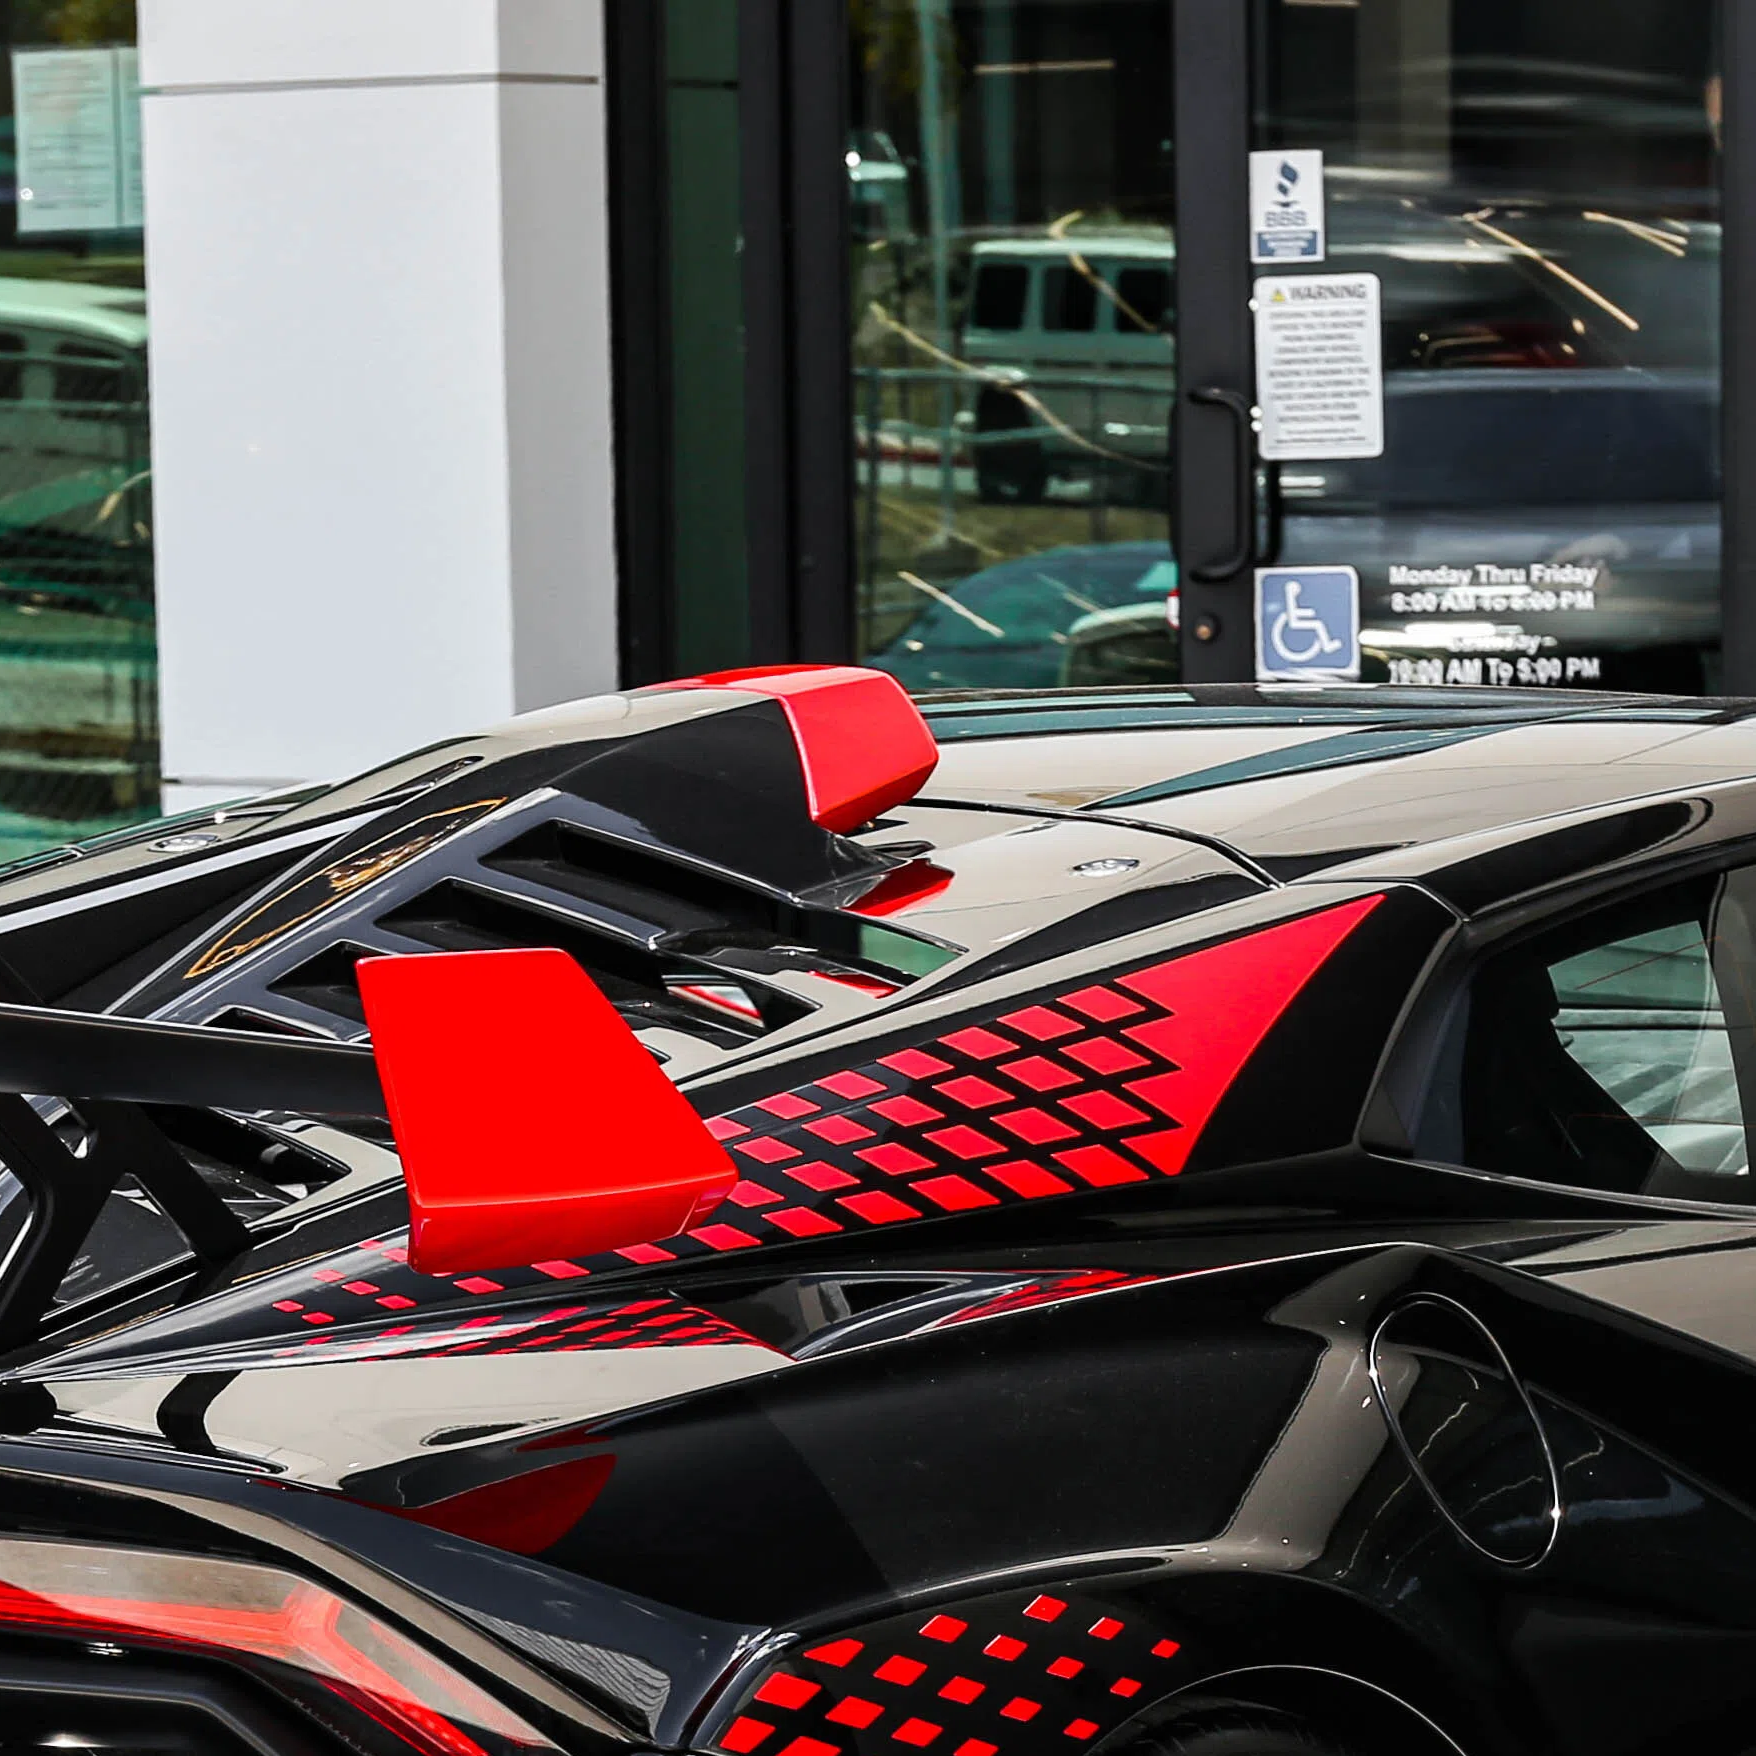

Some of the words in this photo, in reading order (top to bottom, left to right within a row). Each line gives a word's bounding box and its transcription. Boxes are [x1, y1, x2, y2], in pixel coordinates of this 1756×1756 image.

[1288, 284, 1367, 300] WARNING
[1389, 565, 1473, 585] Monday
[1474, 564, 1526, 584] Thru
[1530, 563, 1598, 588] Friday
[1439, 590, 1477, 612] AM
[1560, 590, 1595, 611] PM
[1446, 658, 1483, 684] AM
[1566, 657, 1601, 681] PM
